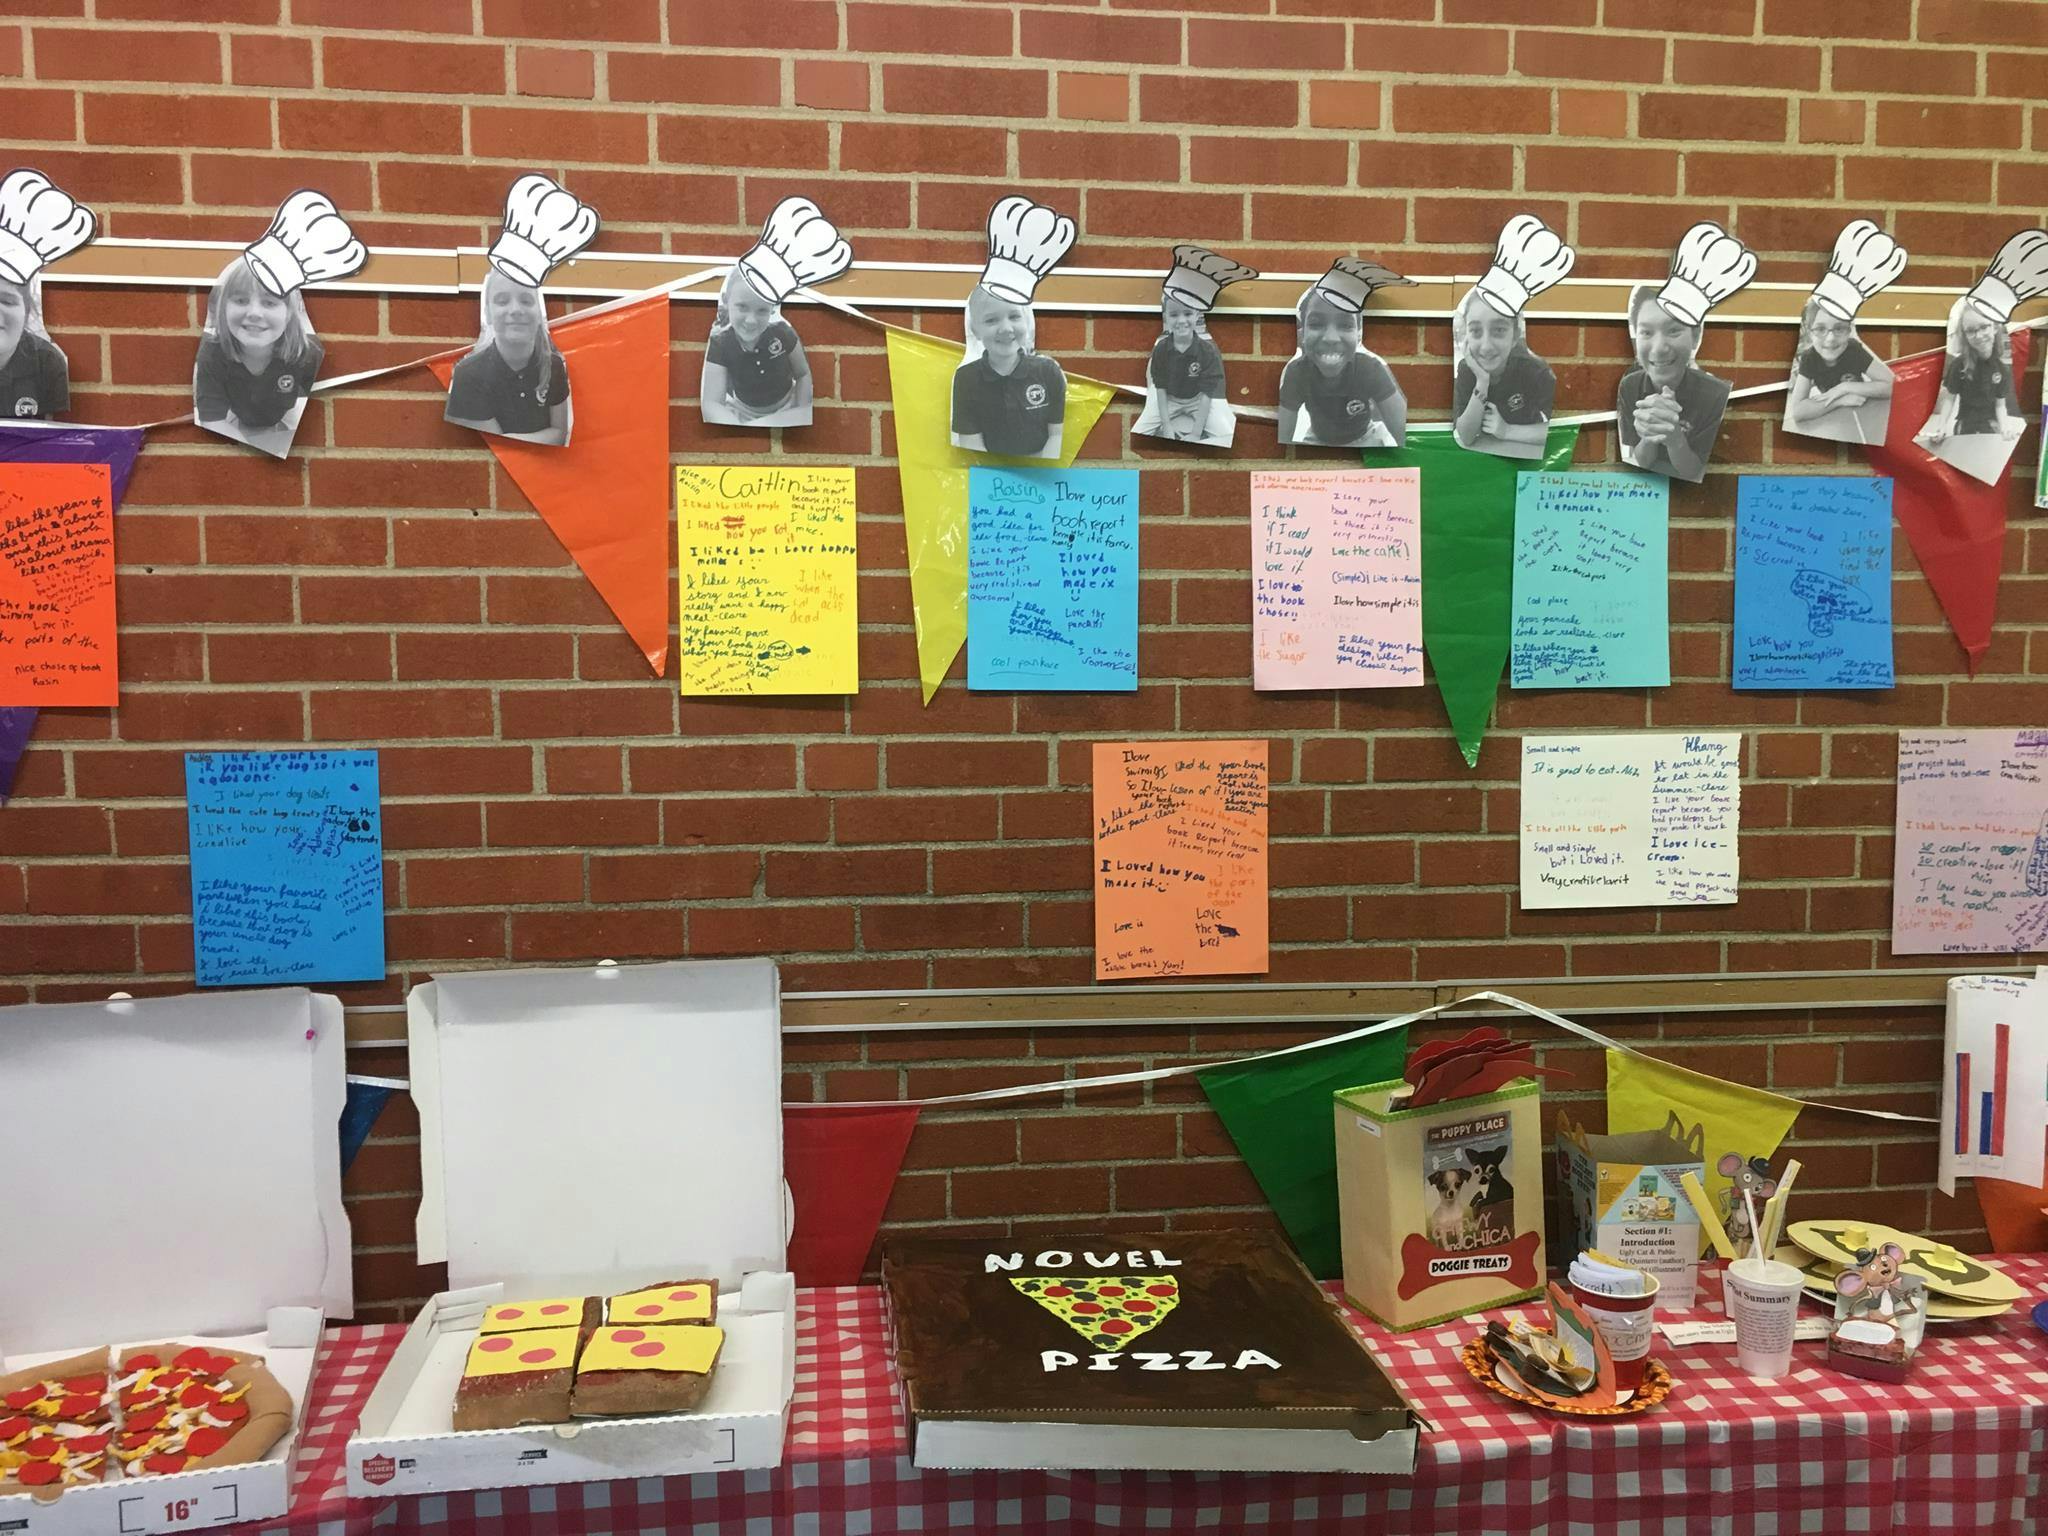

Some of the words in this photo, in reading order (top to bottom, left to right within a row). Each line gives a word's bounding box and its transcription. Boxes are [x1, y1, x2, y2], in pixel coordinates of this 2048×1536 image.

[720, 468, 801, 498] Caitlin
[1092, 494, 1128, 511] your
[32, 508, 52, 522] the
[1276, 506, 1297, 518] think
[1052, 506, 1087, 529] book
[1090, 515, 1125, 535] report
[27, 545, 66, 563] about
[1092, 565, 1117, 576] you
[29, 601, 59, 612] book
[1257, 594, 1273, 604] the
[1281, 594, 1305, 605] book
[1557, 764, 1582, 778] good
[1117, 860, 1154, 871] Loved
[1160, 864, 1181, 876] how
[1184, 870, 1206, 882] you
[1195, 923, 1212, 934] the
[1442, 1124, 1472, 1139] PUPPY
[1475, 1117, 1504, 1132] PLACE
[1463, 1225, 1511, 1249] CHICA
[1624, 1227, 1656, 1235] Section
[1620, 1238, 1675, 1246] Introduction
[984, 1249, 1183, 1272] NOVEL
[1432, 1260, 1470, 1273] DOGGIE
[1473, 1257, 1509, 1270] TREATS
[1744, 1291, 1790, 1304] Summary
[1040, 1349, 1282, 1372] PIZZA
[164, 1498, 199, 1522] 16"
